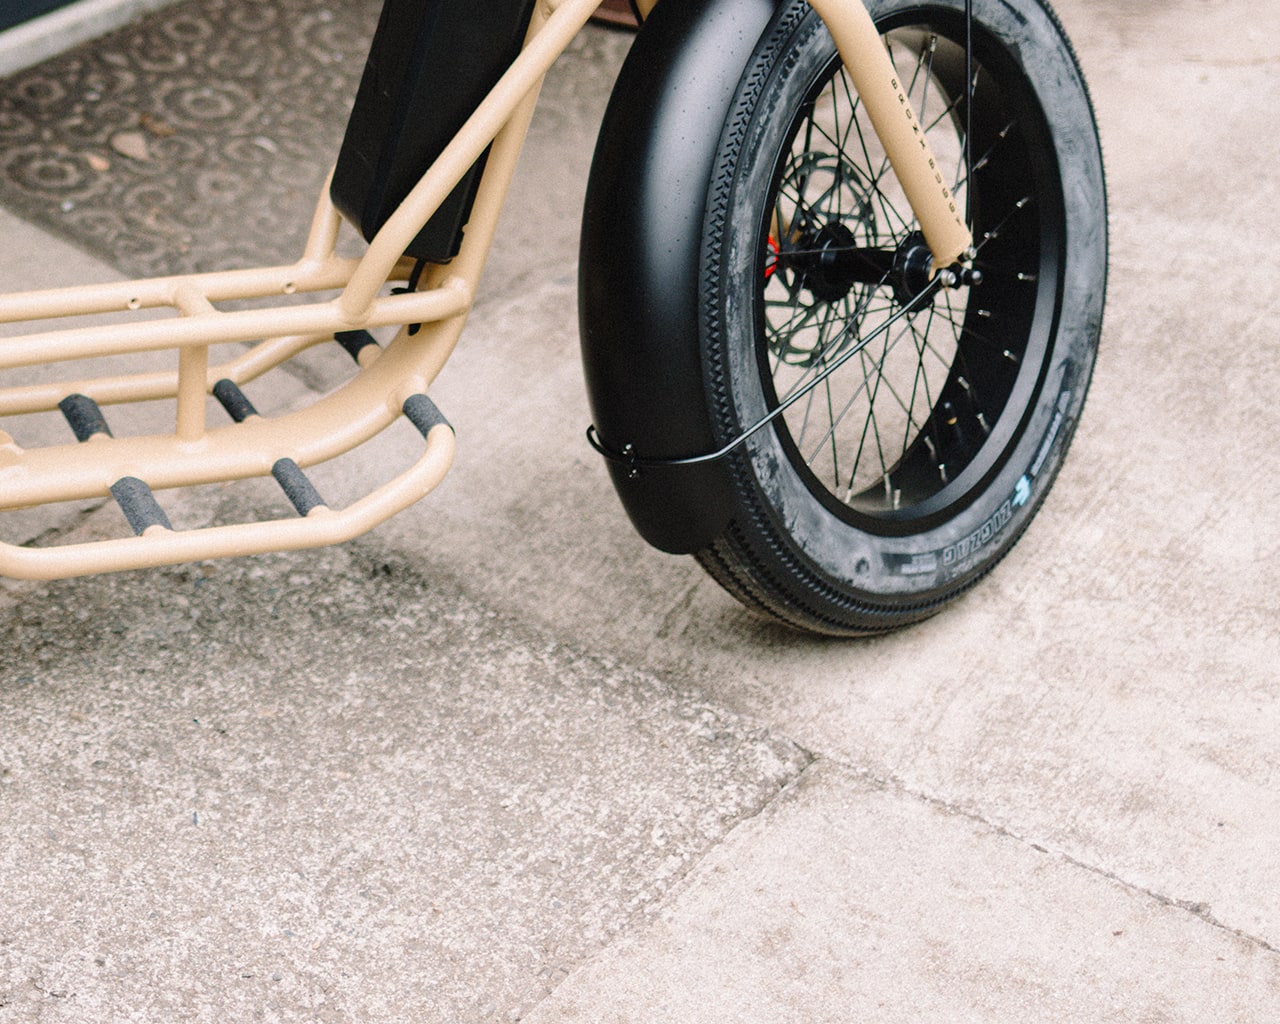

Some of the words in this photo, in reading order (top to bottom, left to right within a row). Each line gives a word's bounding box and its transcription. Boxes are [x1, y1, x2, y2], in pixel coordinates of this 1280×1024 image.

[890, 78, 926, 150] BRONX
[928, 158, 962, 227] BUGGY
[941, 499, 1013, 568] ZIGZAG
